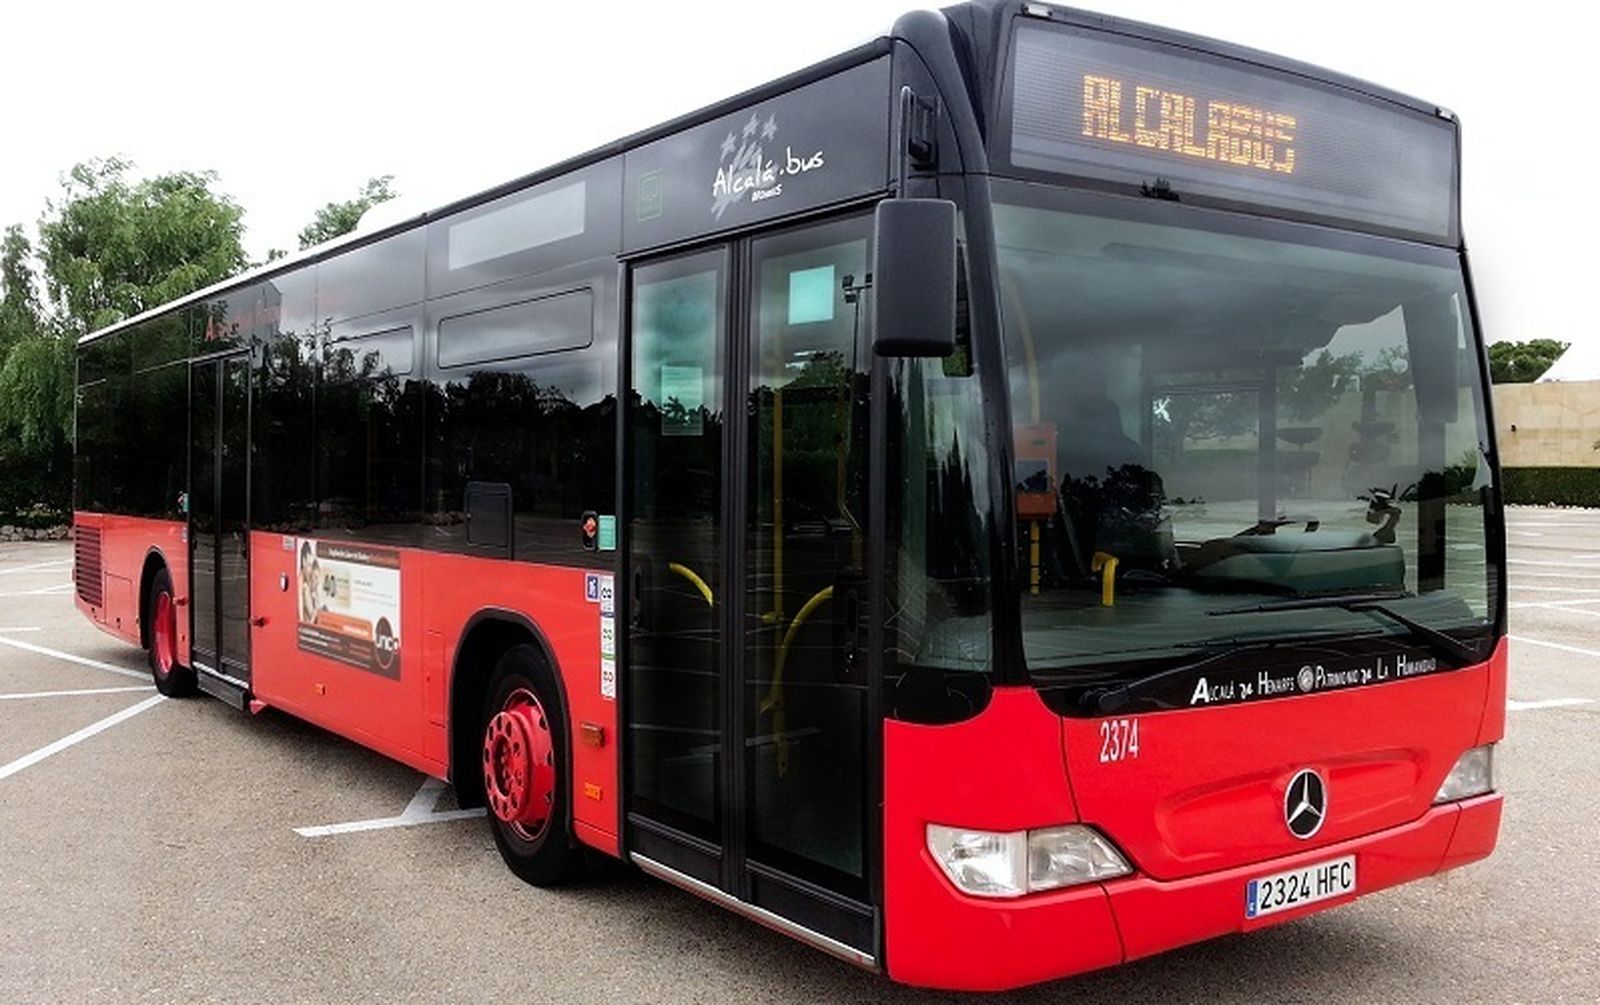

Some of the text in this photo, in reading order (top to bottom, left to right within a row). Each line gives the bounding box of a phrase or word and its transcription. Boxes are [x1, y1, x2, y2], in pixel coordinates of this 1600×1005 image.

[1082, 75, 1296, 173] ALCALABUS
[1100, 718, 1138, 763] 2374
[1260, 862, 1351, 910] 2324 HFC
